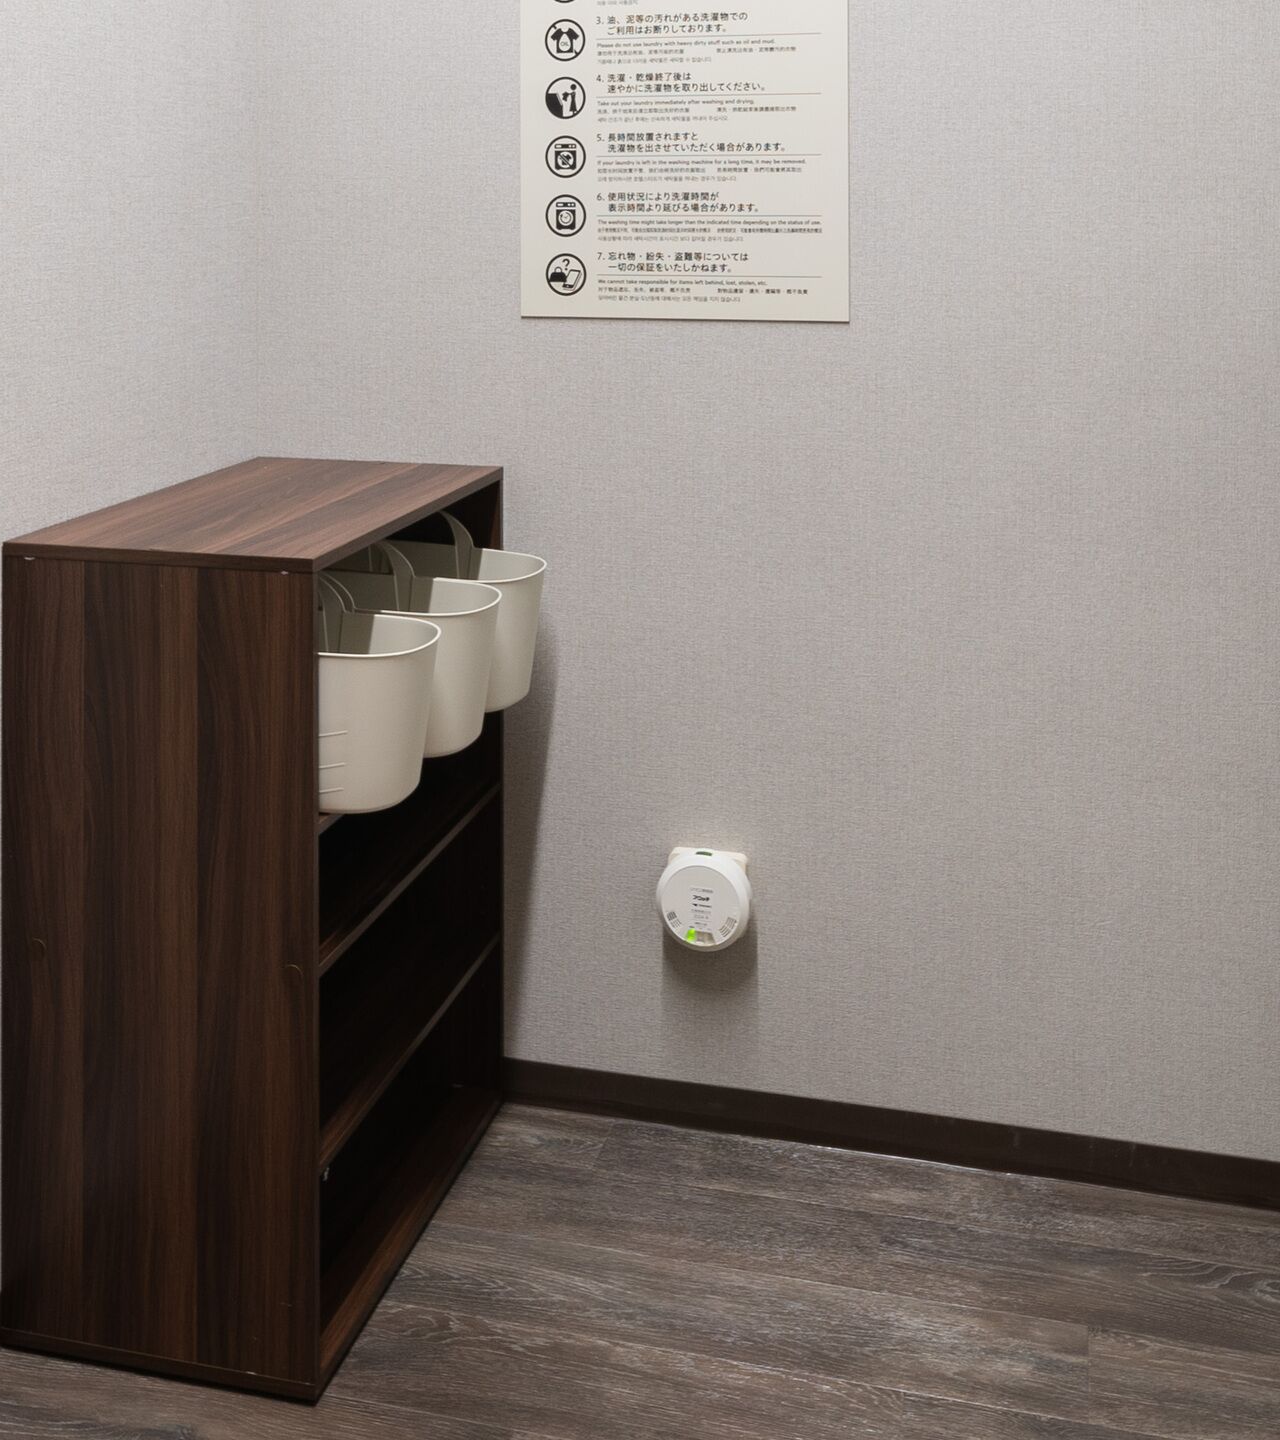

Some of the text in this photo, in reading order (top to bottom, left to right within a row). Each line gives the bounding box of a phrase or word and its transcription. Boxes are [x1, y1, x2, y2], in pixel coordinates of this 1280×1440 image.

[596, 12, 748, 25] 3. 油、泥等の汚れがある洗濯物での
[607, 23, 726, 36] ご利用はお断りしております。
[596, 72, 691, 83] 4. 洗濯・乾燥終了後は
[607, 82, 765, 93] 速やかに洗濯物を取り出してください。
[597, 132, 698, 142] 5. 長時間放置されますと
[608, 142, 785, 153] 洗濯物を出させていただく場合があります。
[597, 191, 719, 202] 6. 使用状況により洗濯時間が
[608, 202, 759, 213] 表示時間より延びる場合があります。
[597, 251, 748, 262] 7. 忘れ物・紛失・盗難等については
[608, 262, 732, 273] 一切の保証をいたしかねます。
